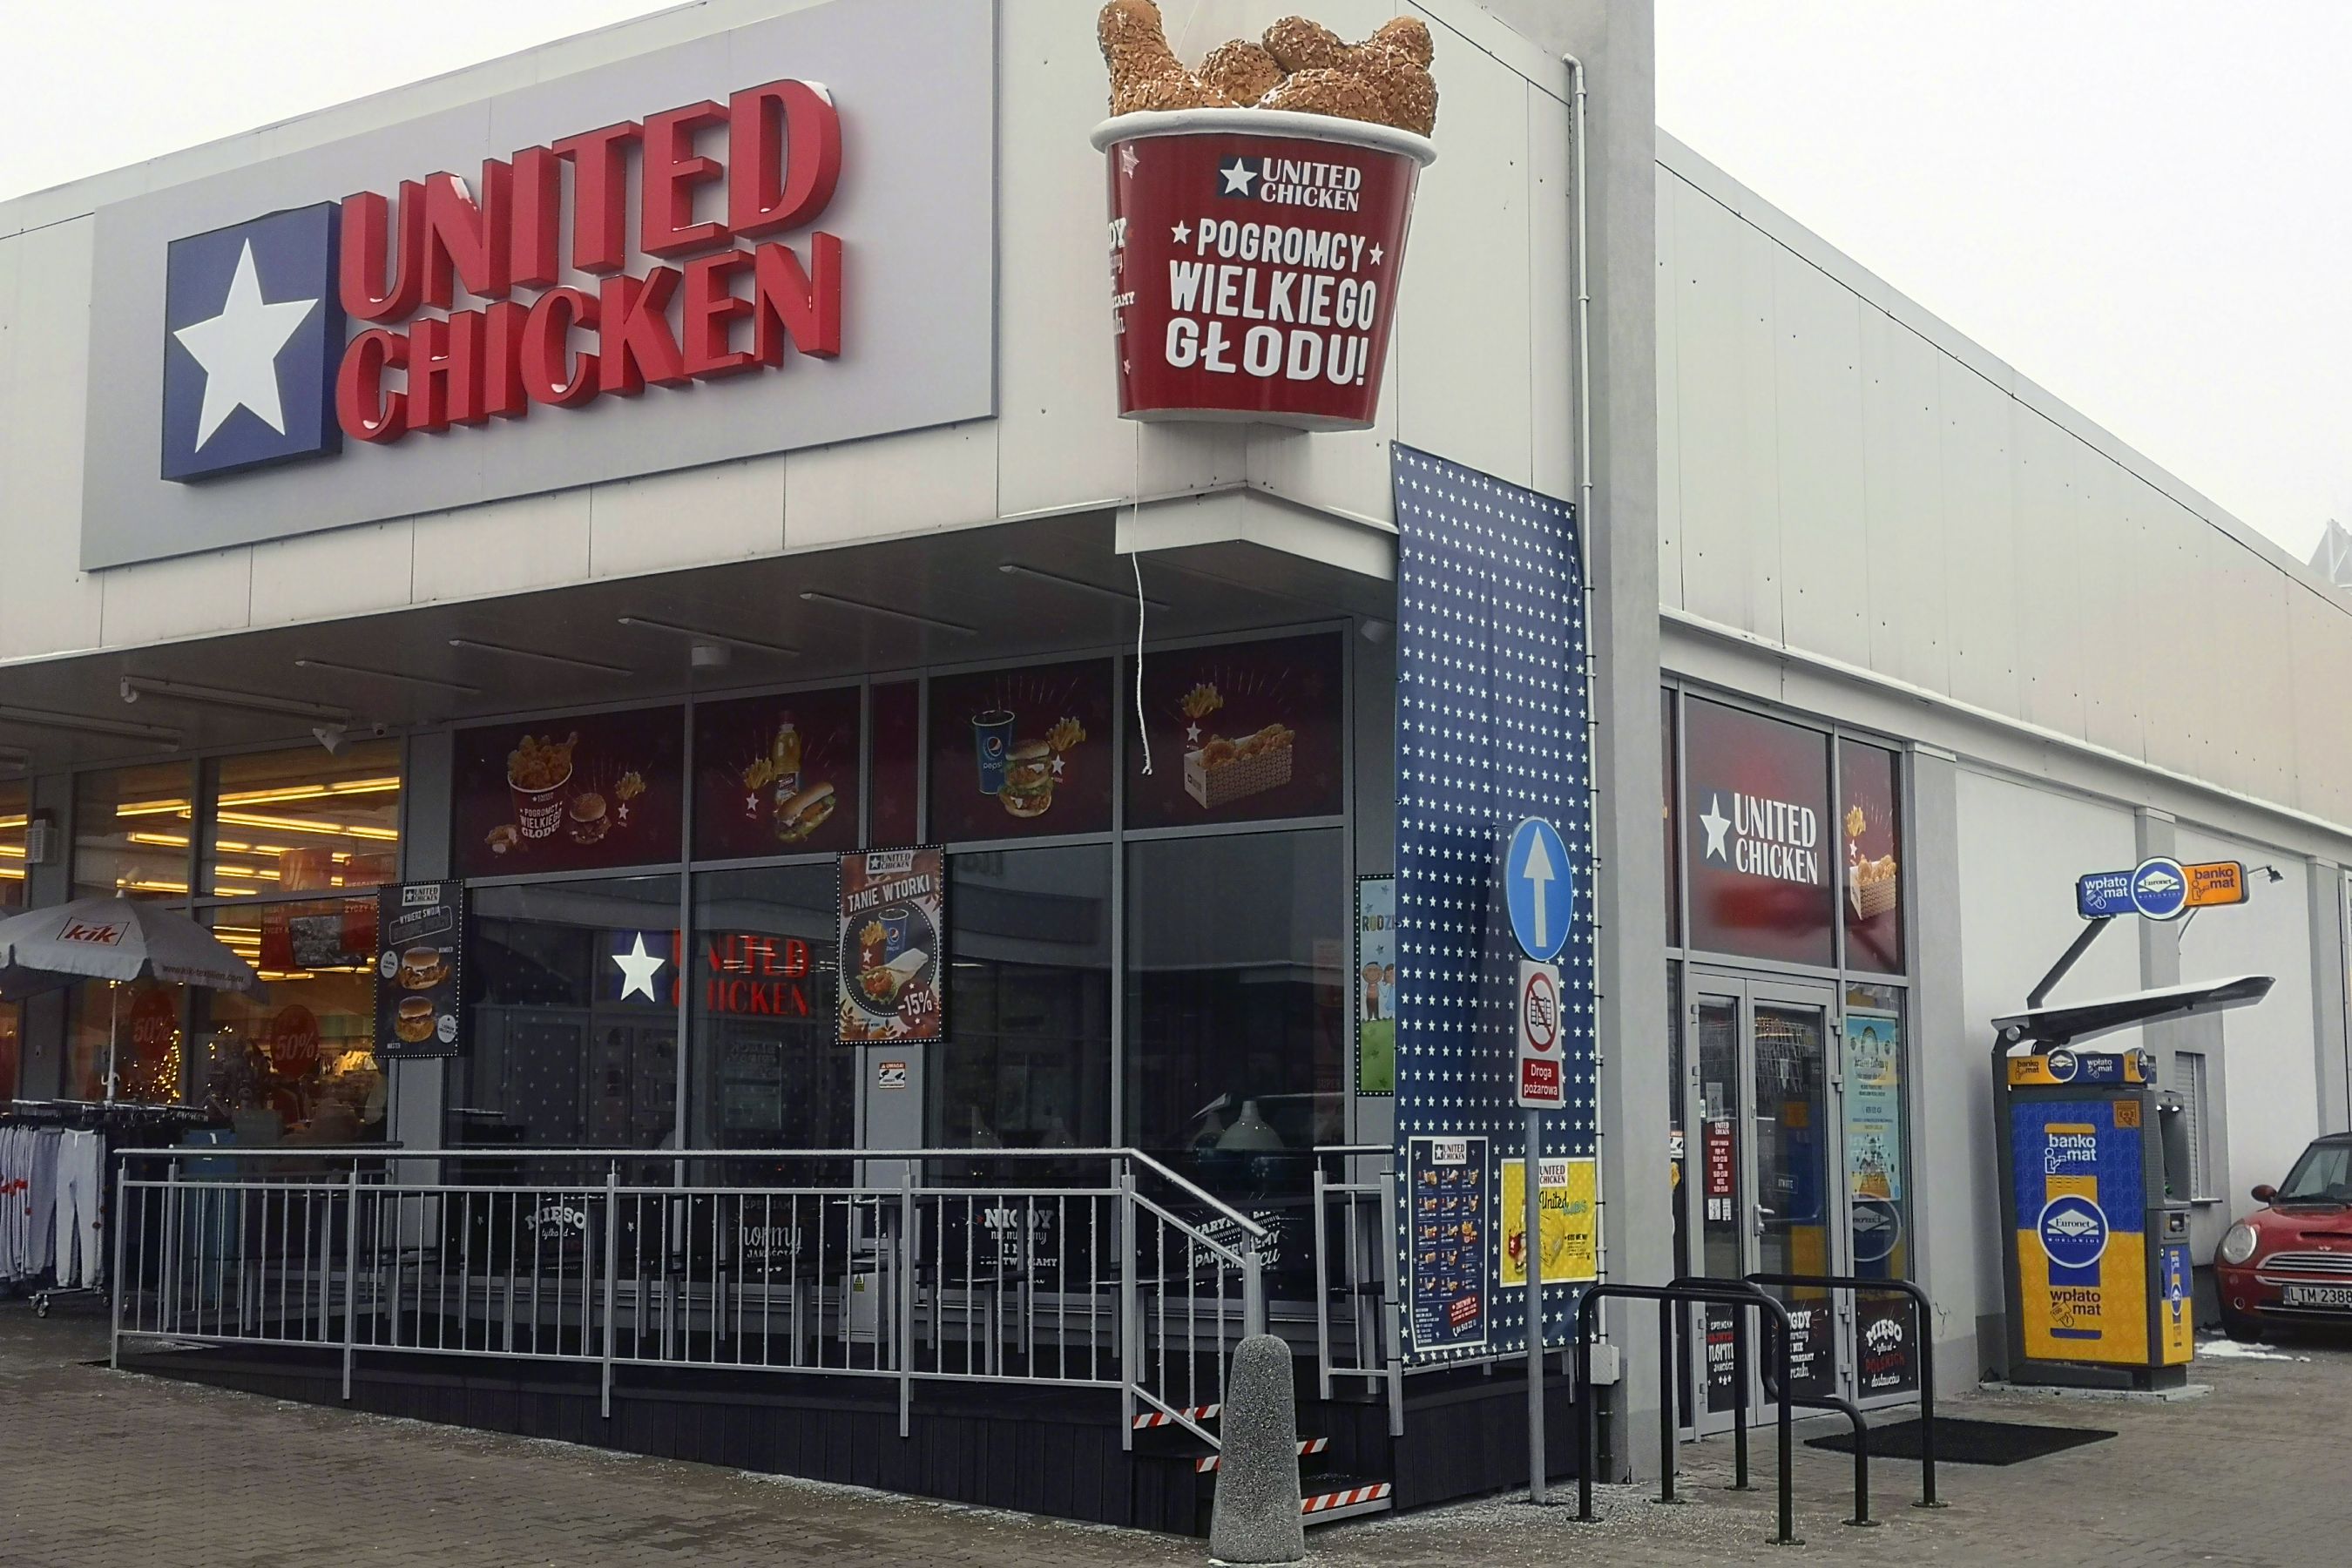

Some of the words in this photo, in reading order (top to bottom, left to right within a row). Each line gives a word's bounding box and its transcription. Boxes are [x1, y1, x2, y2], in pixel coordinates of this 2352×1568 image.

[1262, 158, 1361, 192] UNITED
[340, 78, 841, 323] UNITED
[1260, 182, 1360, 212] CHICKEN
[1198, 218, 1366, 273] POGROMCY
[1169, 260, 1376, 331] WIELKIEGO
[336, 232, 841, 443] CHICKEN
[1166, 317, 1369, 386] GŁODU!
[524, 802, 558, 817] POGROMCY
[519, 808, 562, 829] WIELKIEGO
[1734, 793, 1816, 848] UNITED
[881, 854, 910, 862] UNITED
[1735, 838, 1818, 885] CHICKEN
[881, 862, 909, 870] CHICKEN
[2194, 867, 2234, 880] banko
[2085, 876, 2127, 890] wpłato
[2143, 878, 2173, 887] Euronet
[2210, 877, 2235, 889] mat
[414, 887, 438, 896] UNITED
[848, 888, 879, 912] TANIE
[882, 875, 930, 902] WTORKI
[2104, 887, 2128, 897] mat
[64, 923, 118, 943] kik
[898, 990, 933, 1017] -15%
[275, 1031, 314, 1061] 50%
[2087, 1058, 2112, 1068] wpłato
[1531, 1063, 1551, 1080] Droga
[1524, 1081, 1558, 1096] pożarowa
[1443, 1144, 1464, 1152] UNITED
[2049, 1133, 2097, 1148] banko
[2067, 1148, 2097, 1161] mat
[1539, 1166, 1565, 1175] UNITED
[1539, 1175, 1565, 1185] CHICKEN
[1538, 1191, 1568, 1209] United
[2056, 1218, 2091, 1227] Euronet
[2050, 1288, 2100, 1303] wpłato
[2290, 1288, 2316, 1301] LTM
[2321, 1289, 2352, 1303] 2388
[2073, 1304, 2101, 1315] mat
[1866, 1319, 1903, 1347] MIĘSO
[1708, 1342, 1734, 1362] norm
